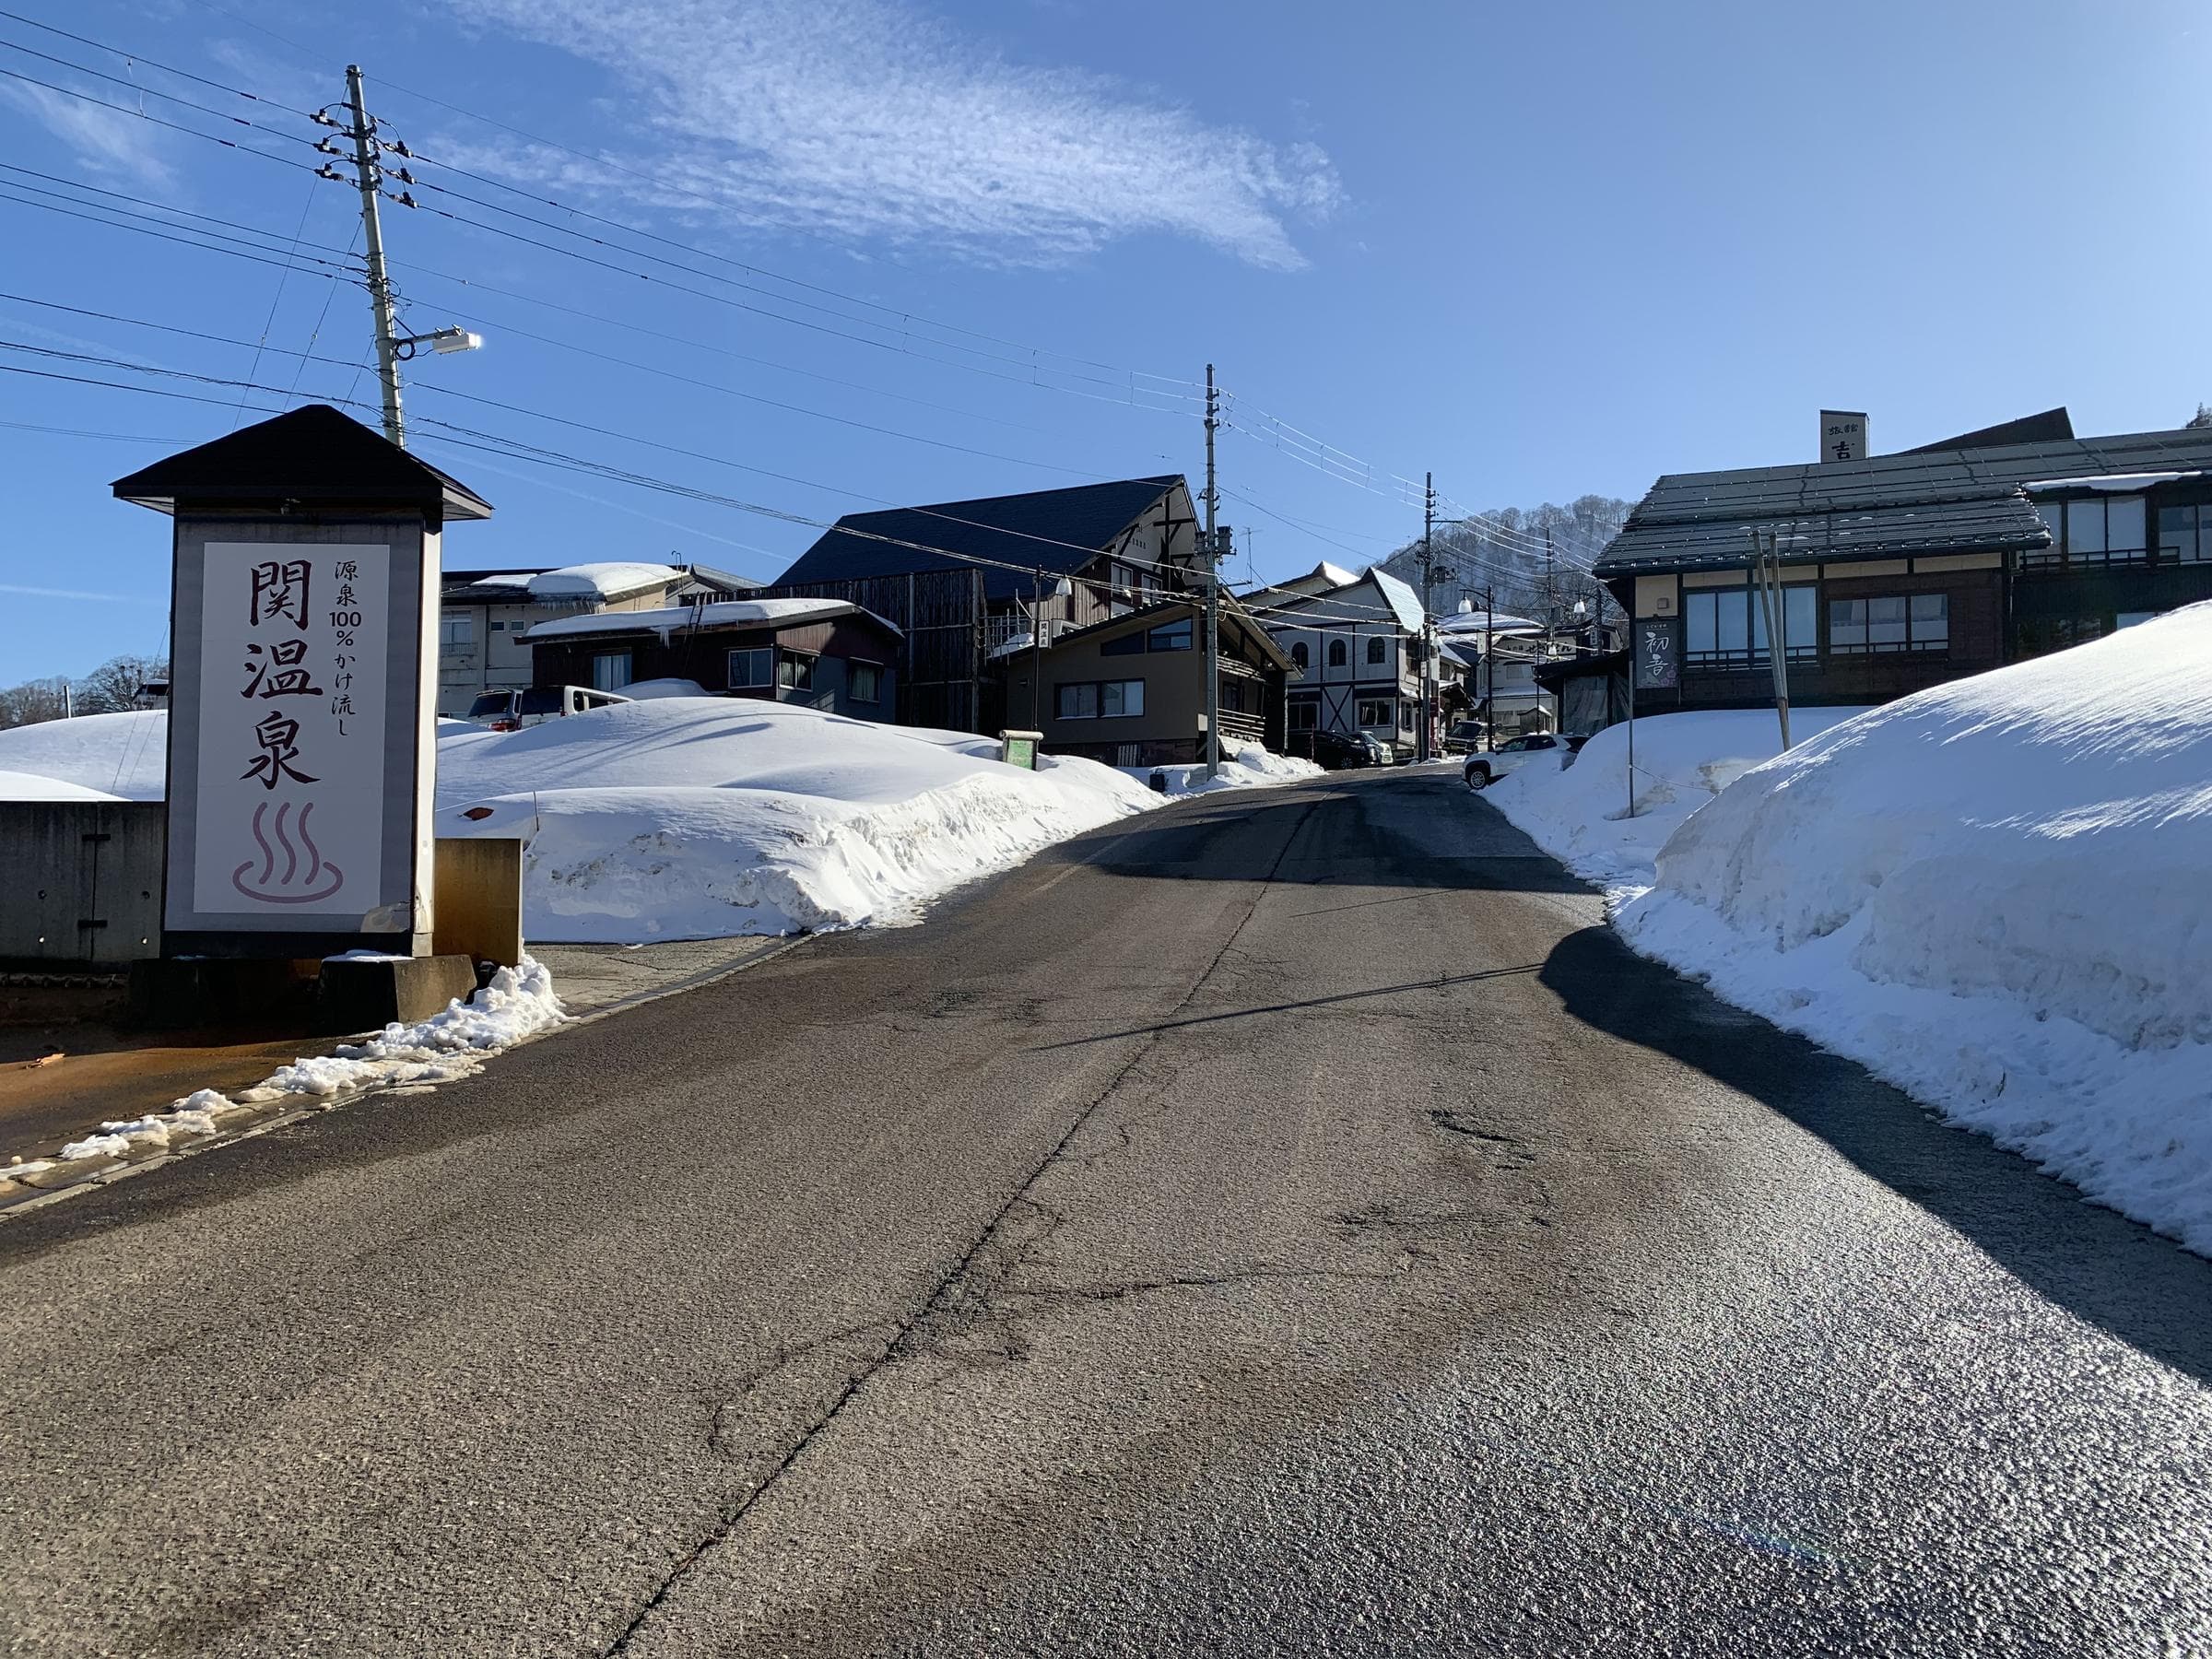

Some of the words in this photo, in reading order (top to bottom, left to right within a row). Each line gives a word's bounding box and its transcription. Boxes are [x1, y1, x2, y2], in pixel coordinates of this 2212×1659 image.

[1828, 423, 1858, 435] 旅館
[239, 559, 324, 791] 関温泉
[328, 559, 362, 736] 源泉100%かけ流し
[1645, 631, 1669, 677] 初音
